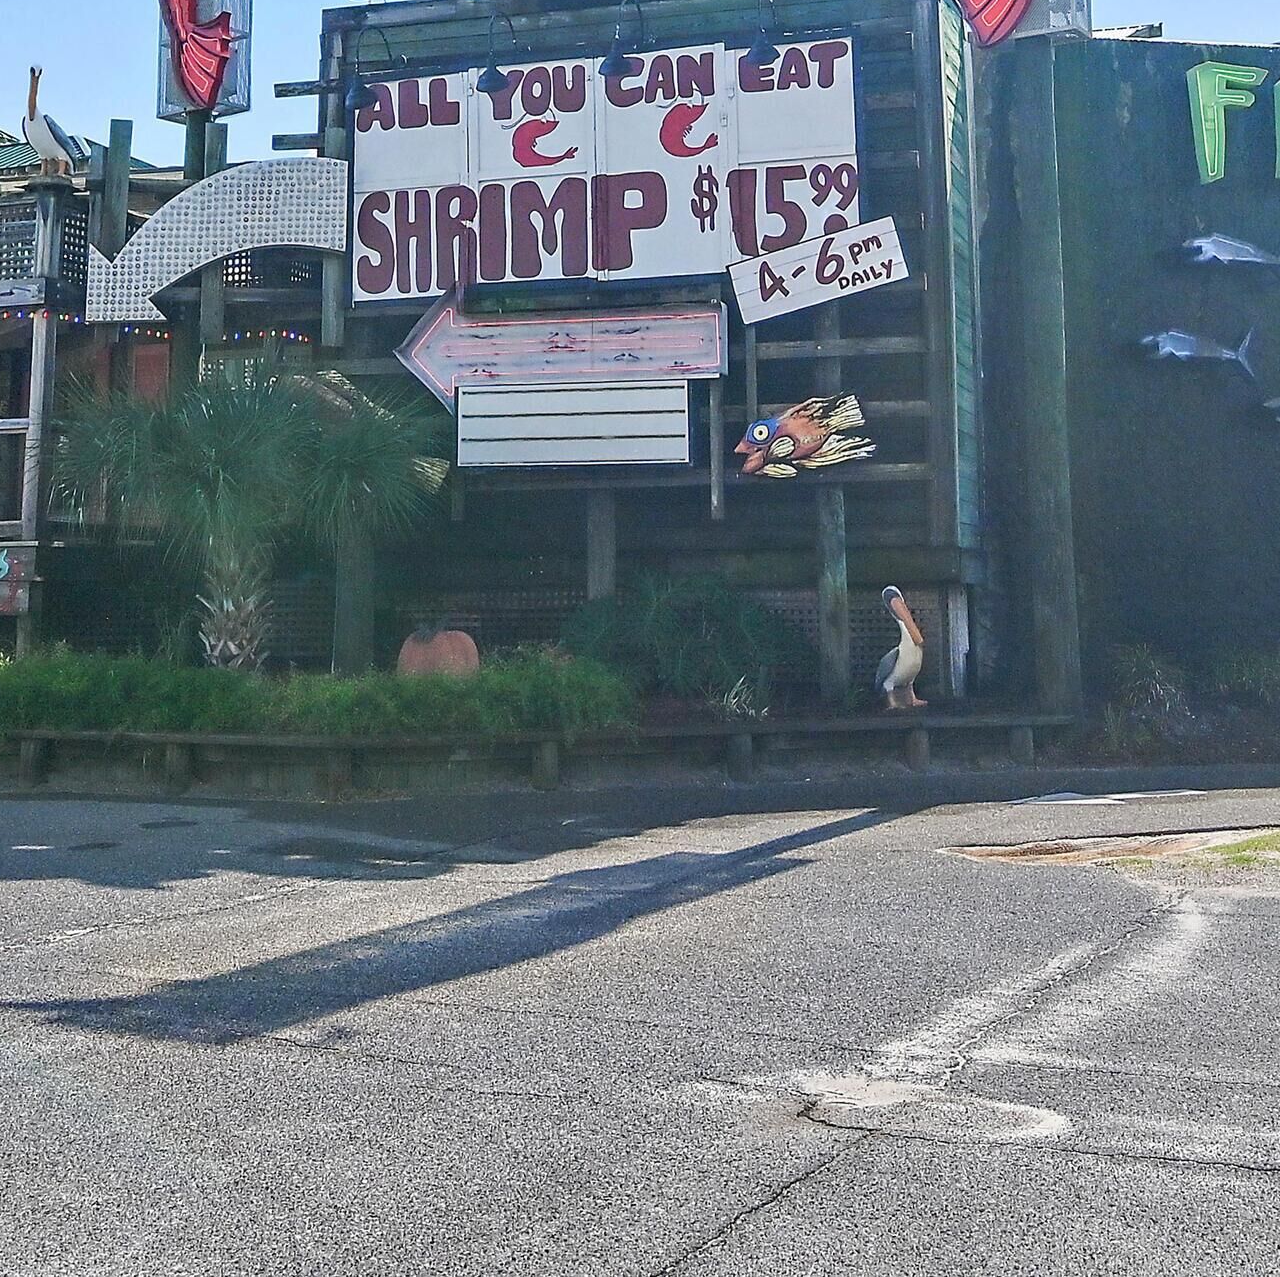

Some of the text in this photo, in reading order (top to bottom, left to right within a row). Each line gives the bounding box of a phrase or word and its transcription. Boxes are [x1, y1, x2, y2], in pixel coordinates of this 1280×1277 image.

[356, 40, 849, 133] ALL YOU CAN EAT
[356, 171, 668, 296] SHRIMP
[837, 259, 893, 290] DAILY
